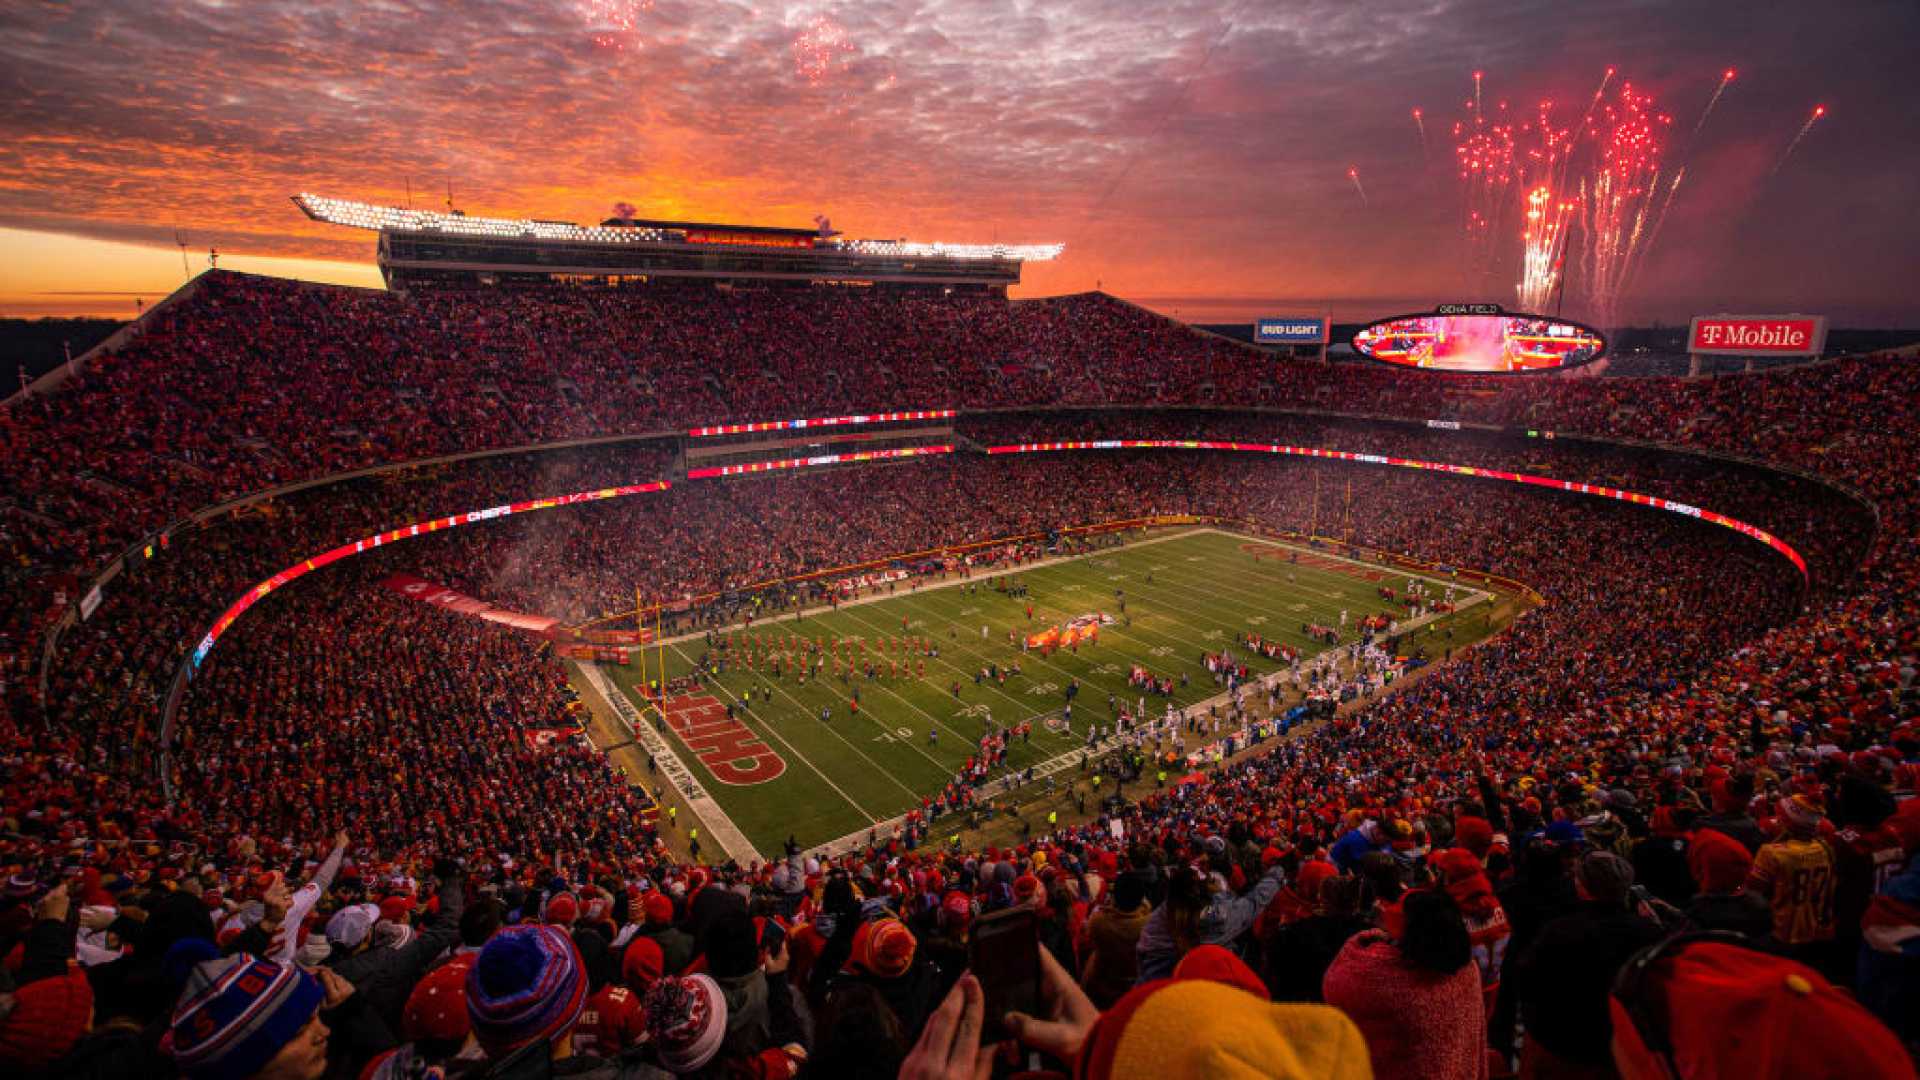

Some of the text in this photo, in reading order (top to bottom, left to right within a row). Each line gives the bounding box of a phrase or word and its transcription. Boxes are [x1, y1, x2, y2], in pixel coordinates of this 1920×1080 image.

[1440, 304, 1498, 314] GEHA FIELD
[1262, 325, 1318, 336] BUD LIGHT
[1724, 324, 1805, 346] Mobile
